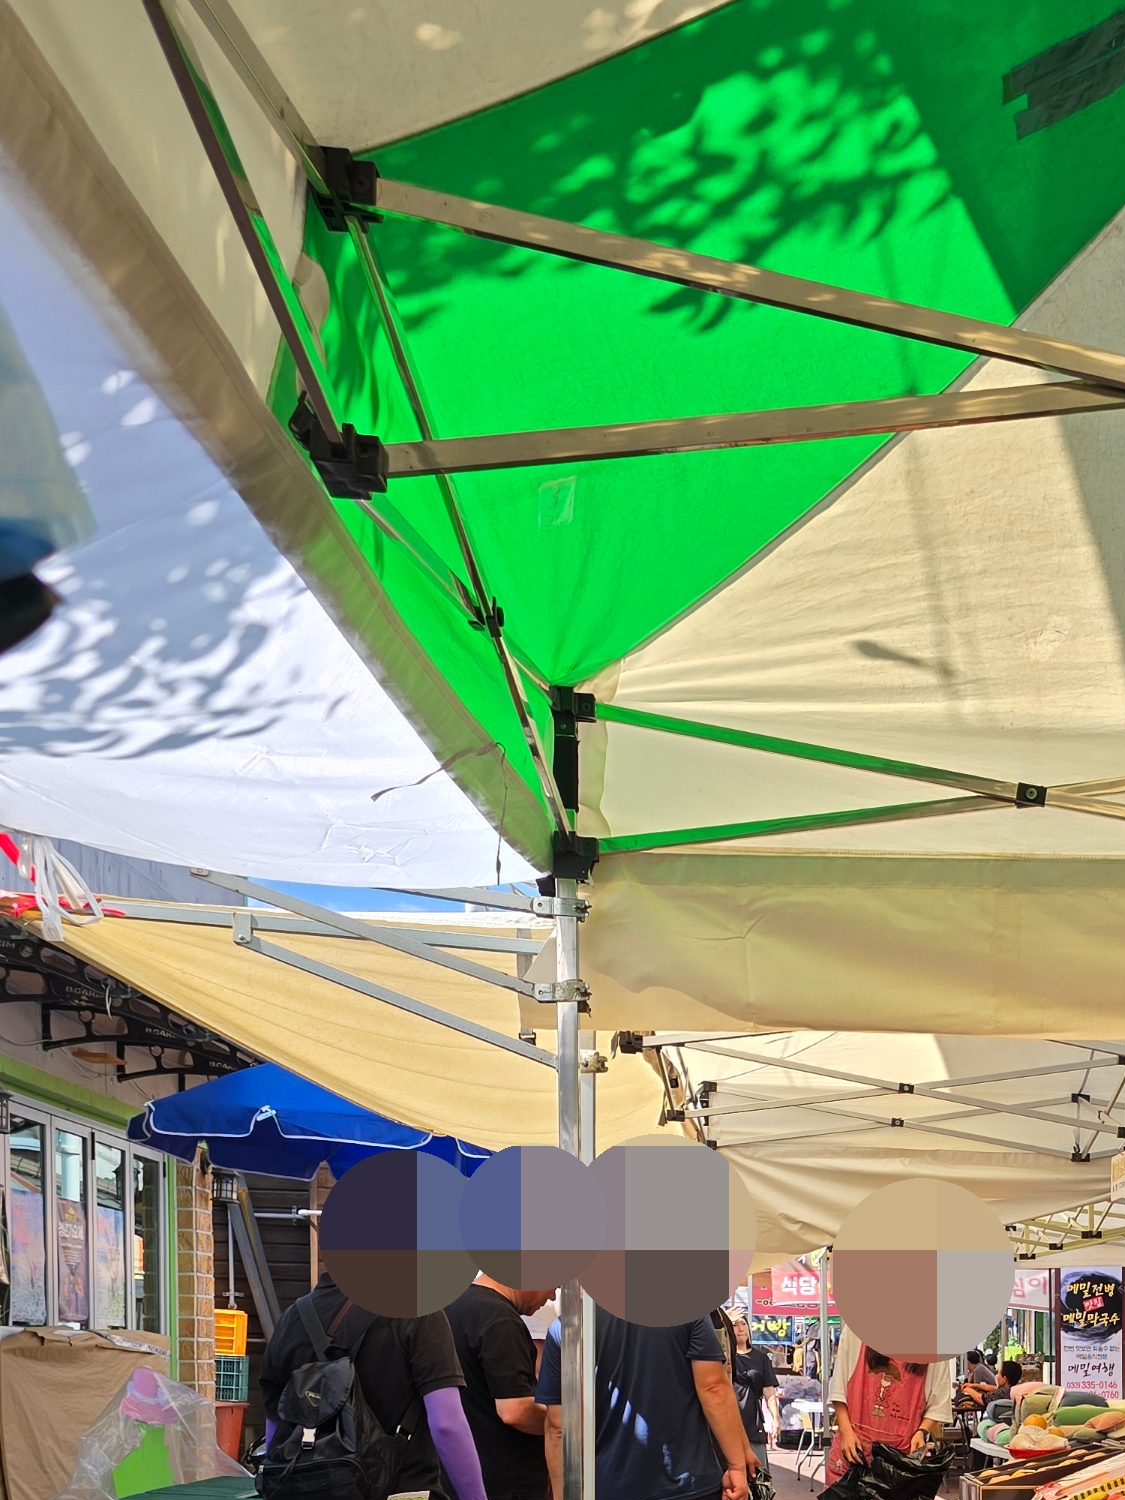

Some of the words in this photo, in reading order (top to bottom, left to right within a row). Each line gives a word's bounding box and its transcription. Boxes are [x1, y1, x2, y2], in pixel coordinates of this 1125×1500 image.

[781, 1276, 818, 1296] 식당
[1066, 1282, 1115, 1299] 메밀전병
[1063, 1310, 1120, 1329] 메밀막국수
[1068, 1362, 1115, 1377] 메밀여행
